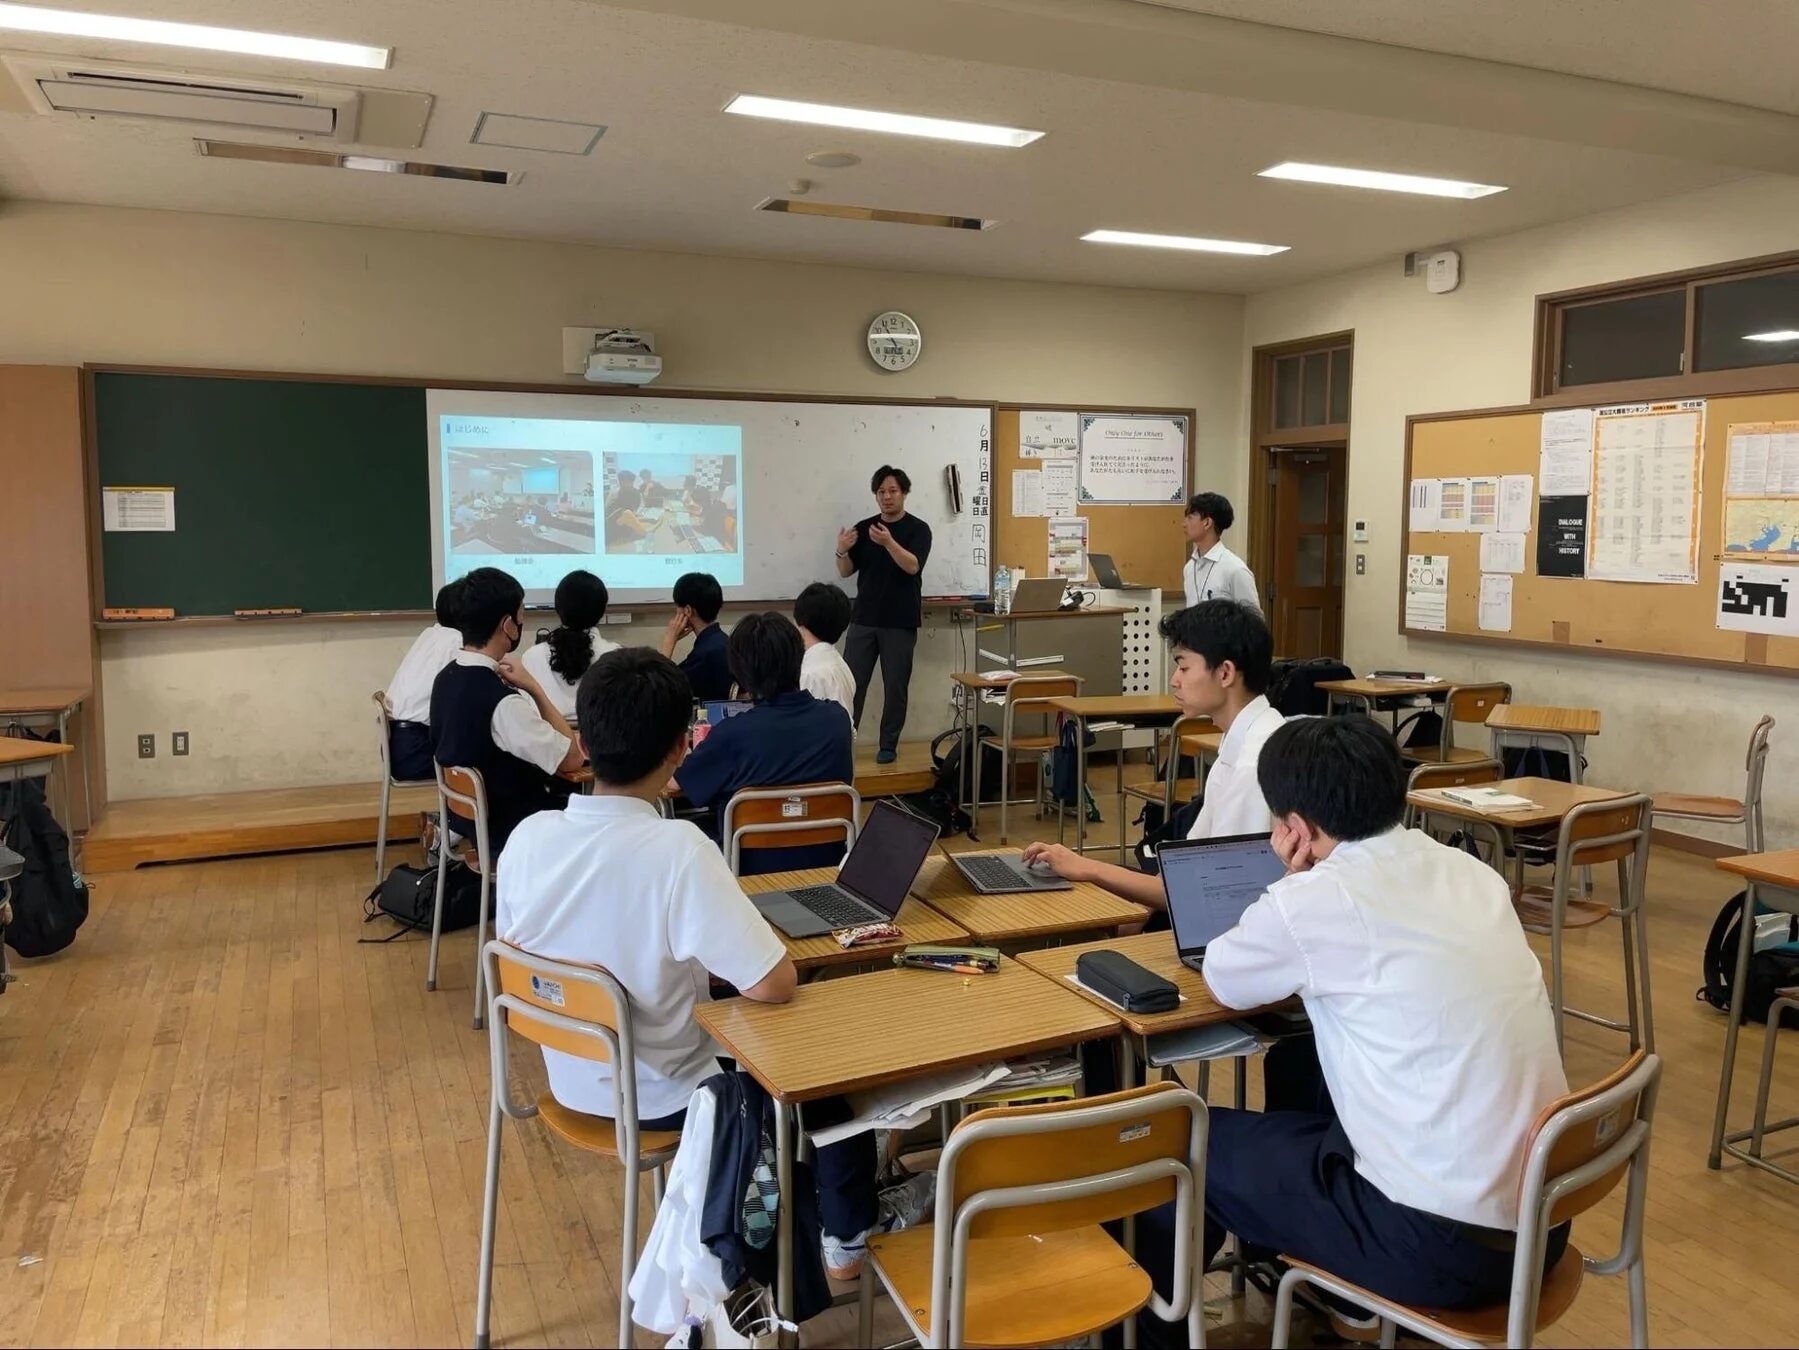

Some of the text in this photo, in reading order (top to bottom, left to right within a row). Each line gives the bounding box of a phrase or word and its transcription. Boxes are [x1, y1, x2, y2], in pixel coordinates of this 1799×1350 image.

[454, 423, 489, 433] はじめに
[1558, 518, 1583, 526] DIALOGUE
